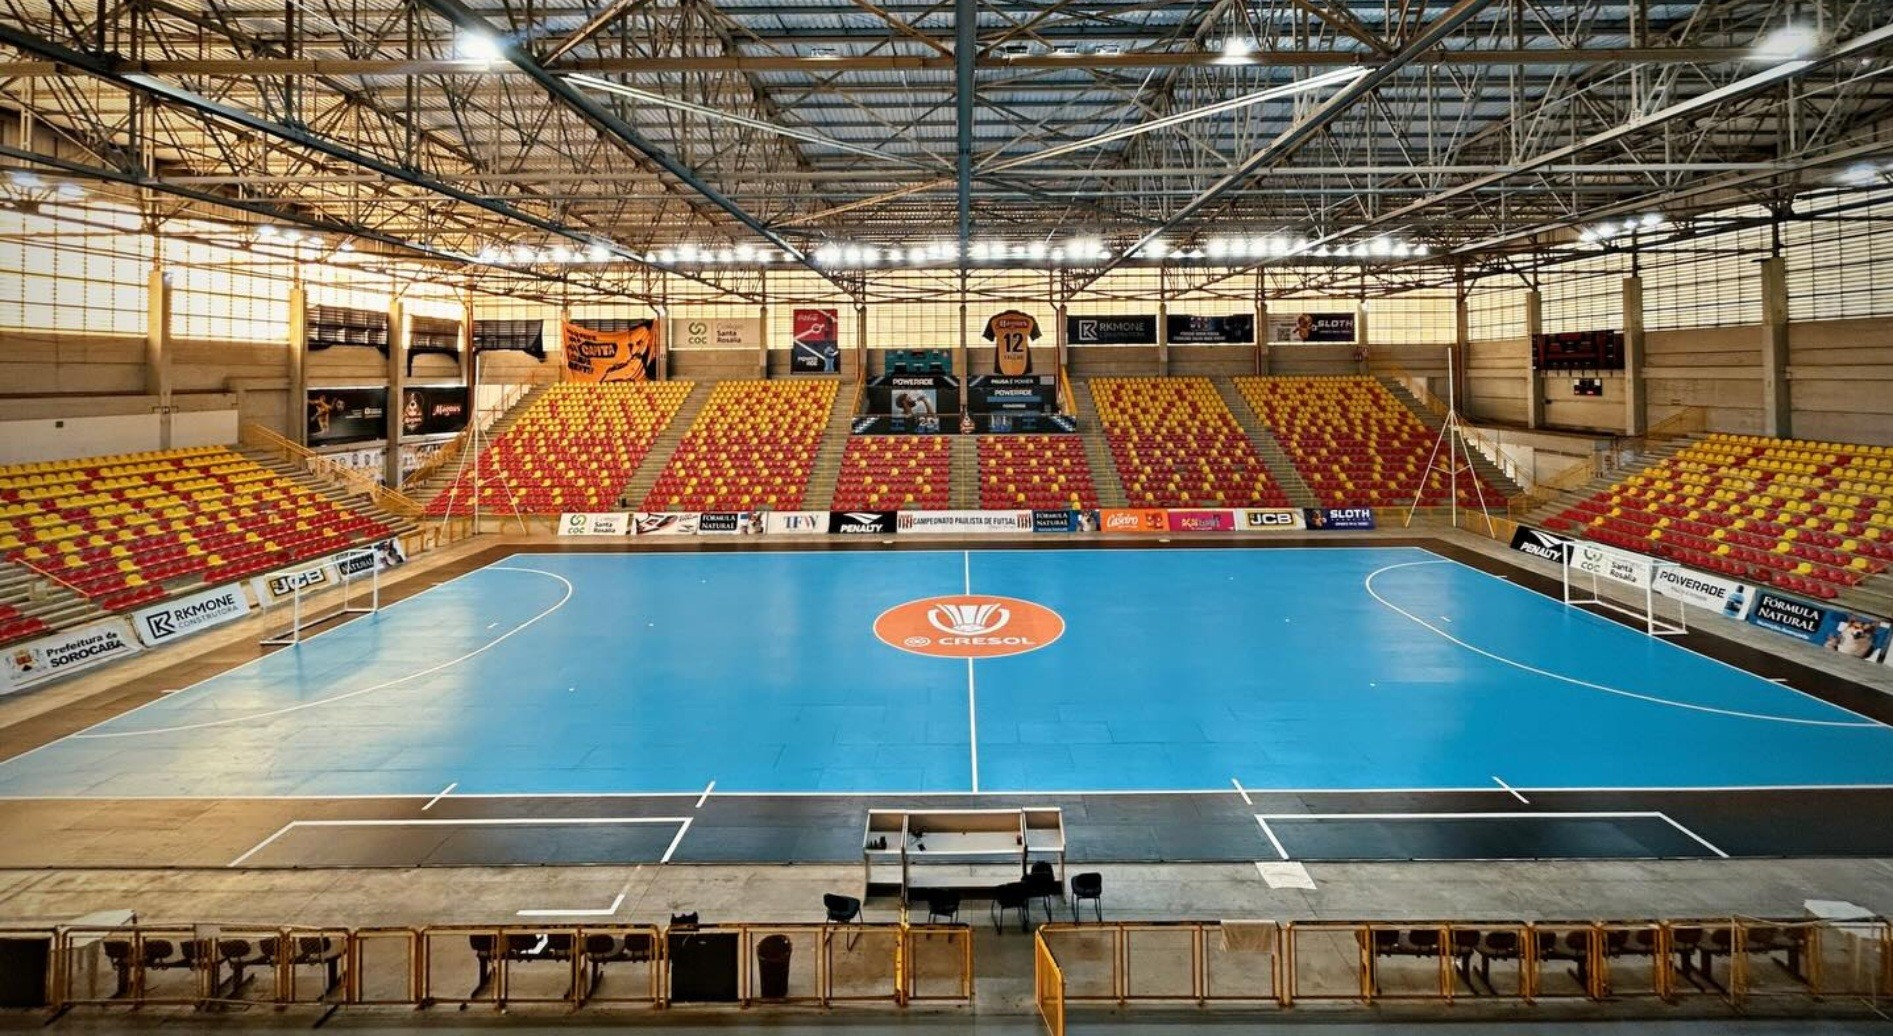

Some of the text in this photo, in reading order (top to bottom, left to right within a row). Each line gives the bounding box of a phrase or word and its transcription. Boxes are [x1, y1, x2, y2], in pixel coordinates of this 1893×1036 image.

[1100, 322, 1145, 332] RKMONE
[1317, 320, 1354, 328] SLOTH
[688, 336, 707, 344] COC
[1003, 333, 1024, 353] 12
[892, 378, 934, 386] POWERADE
[1250, 512, 1293, 525] JCB
[1329, 509, 1371, 519] SLOTH
[701, 521, 736, 530] NATURAL
[913, 516, 1016, 525] CAMPEONATO PAULISTA DE FUTSAL
[567, 526, 585, 534] COC
[840, 523, 885, 533] PENALTY
[1520, 541, 1562, 561] PENALTY
[1580, 561, 1601, 573] COC
[1611, 560, 1633, 574] Santa
[271, 567, 326, 596] JCB
[1659, 570, 1727, 599] POWERADE
[174, 593, 235, 621] RKMONE
[178, 605, 239, 628] CONSTRUTORA
[1757, 607, 1816, 632] NATURAL
[46, 631, 118, 657] Prefeitura de
[938, 636, 1037, 646] CRESOL
[50, 640, 126, 668] SOROCABA
